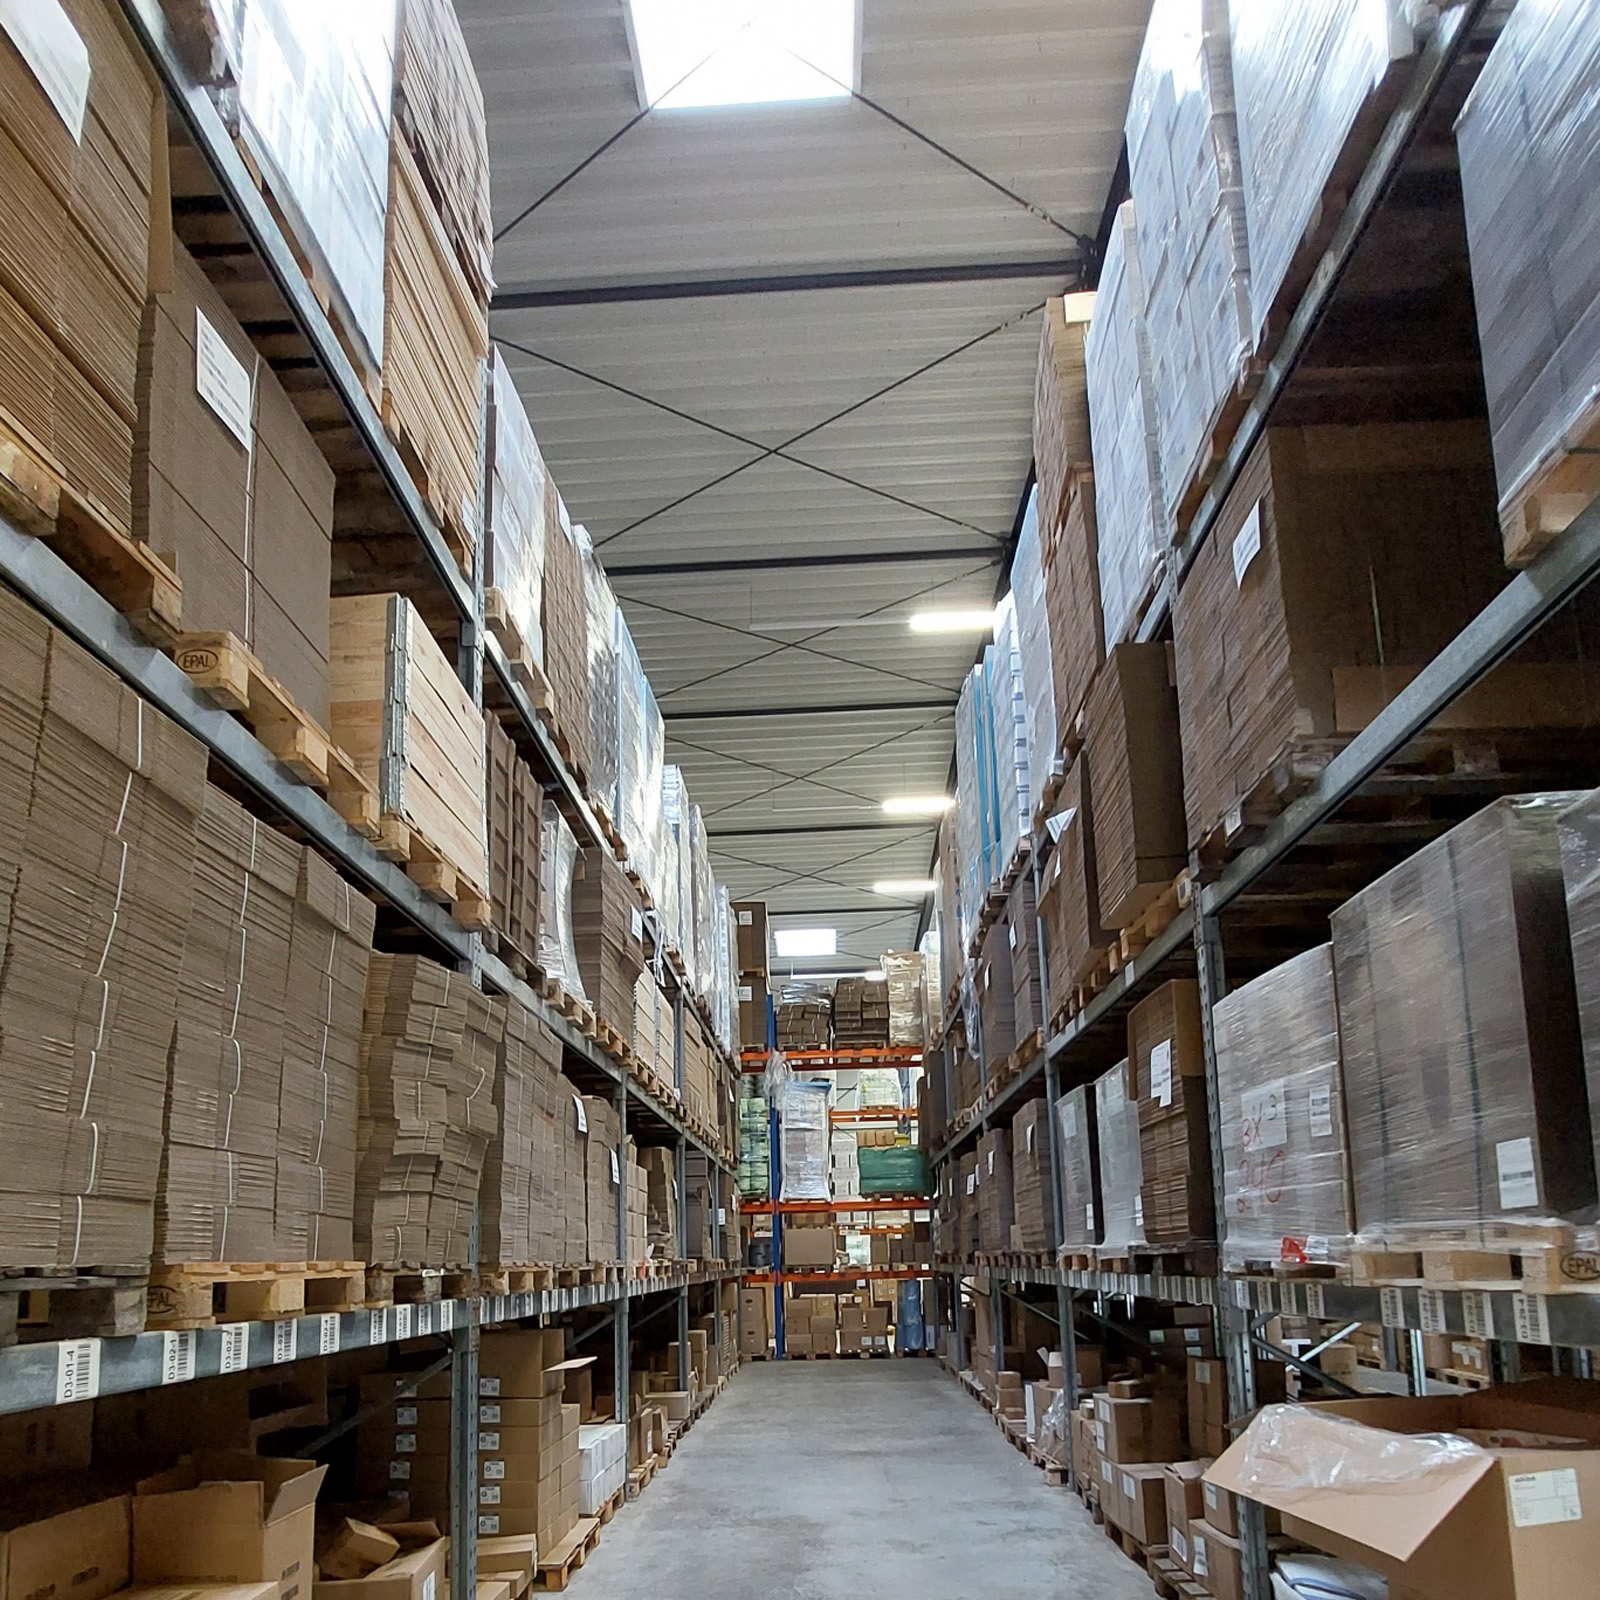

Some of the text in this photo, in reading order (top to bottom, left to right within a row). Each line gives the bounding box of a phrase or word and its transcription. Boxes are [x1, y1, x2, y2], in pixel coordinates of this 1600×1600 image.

[182, 654, 211, 669] EPAL
[1568, 1257, 1600, 1274] EPAL
[64, 1350, 75, 1398] D3-01-4
[168, 1339, 177, 1380] D3-02-1
